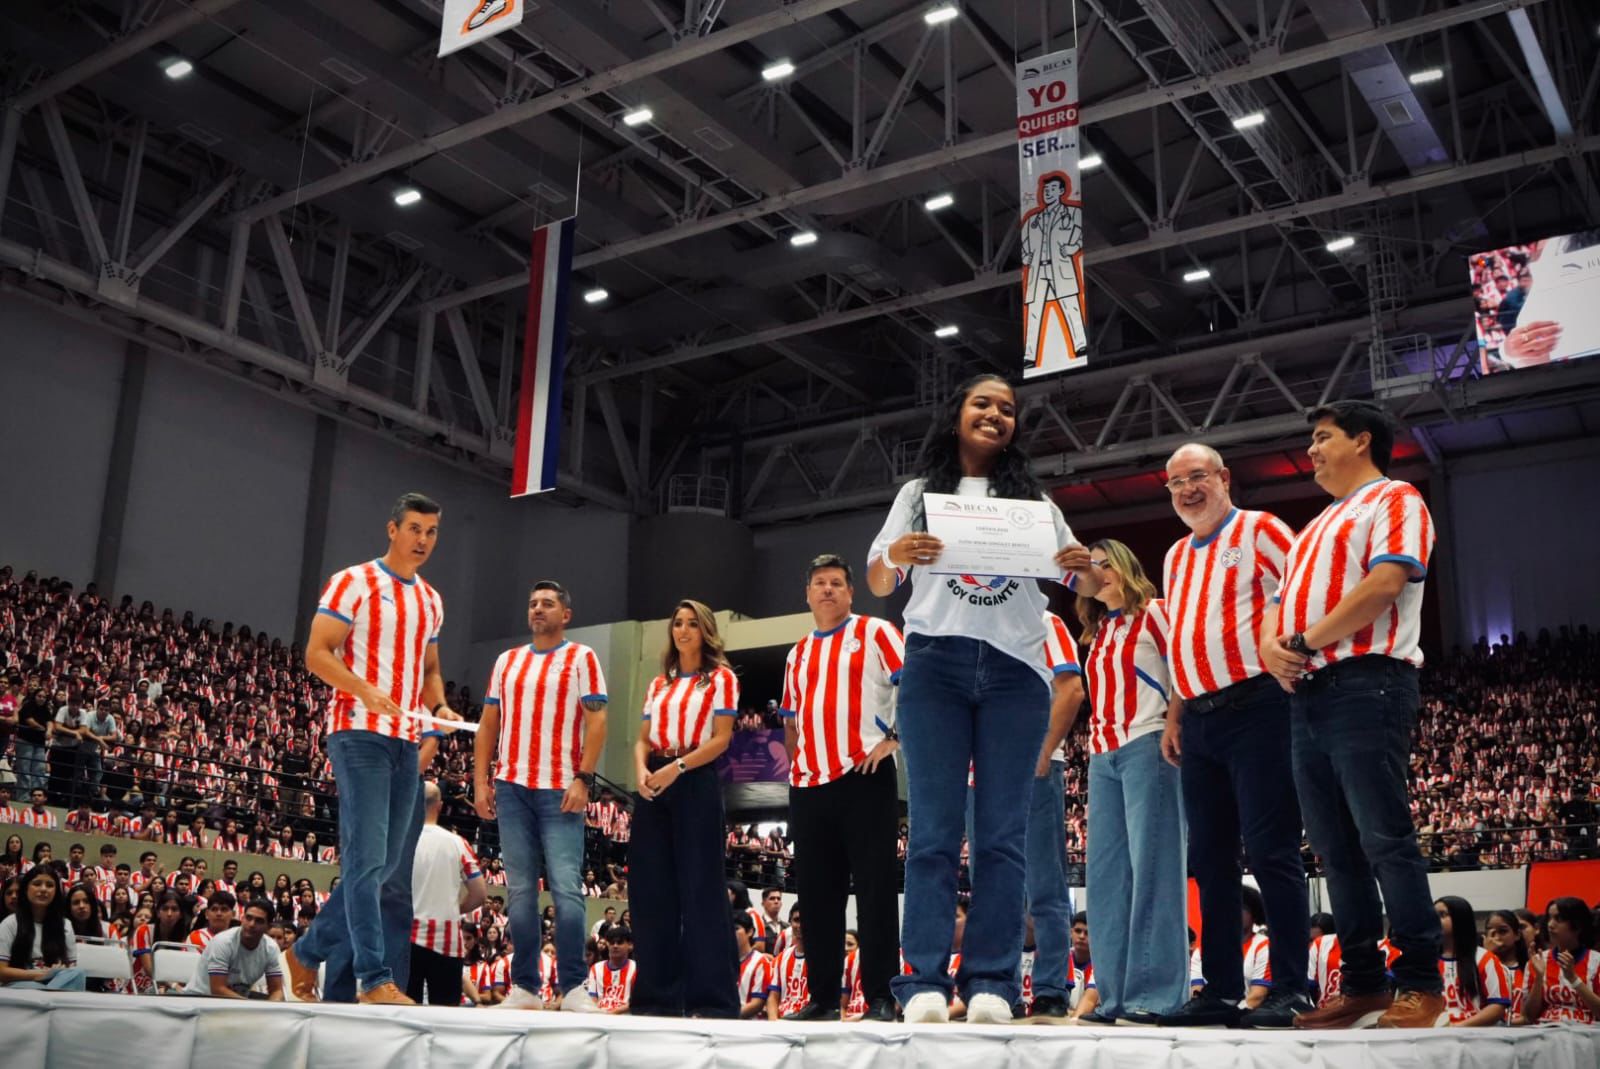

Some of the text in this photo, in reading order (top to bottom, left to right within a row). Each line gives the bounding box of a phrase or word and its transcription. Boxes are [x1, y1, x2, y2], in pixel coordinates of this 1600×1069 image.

[1043, 58, 1073, 72] BECAS
[1027, 80, 1067, 108] YO
[1020, 108, 1077, 133] QUIERO
[1023, 137, 1076, 158] SER...
[963, 503, 999, 513] BECAS
[946, 578, 1020, 606] SOY GIGANTE
